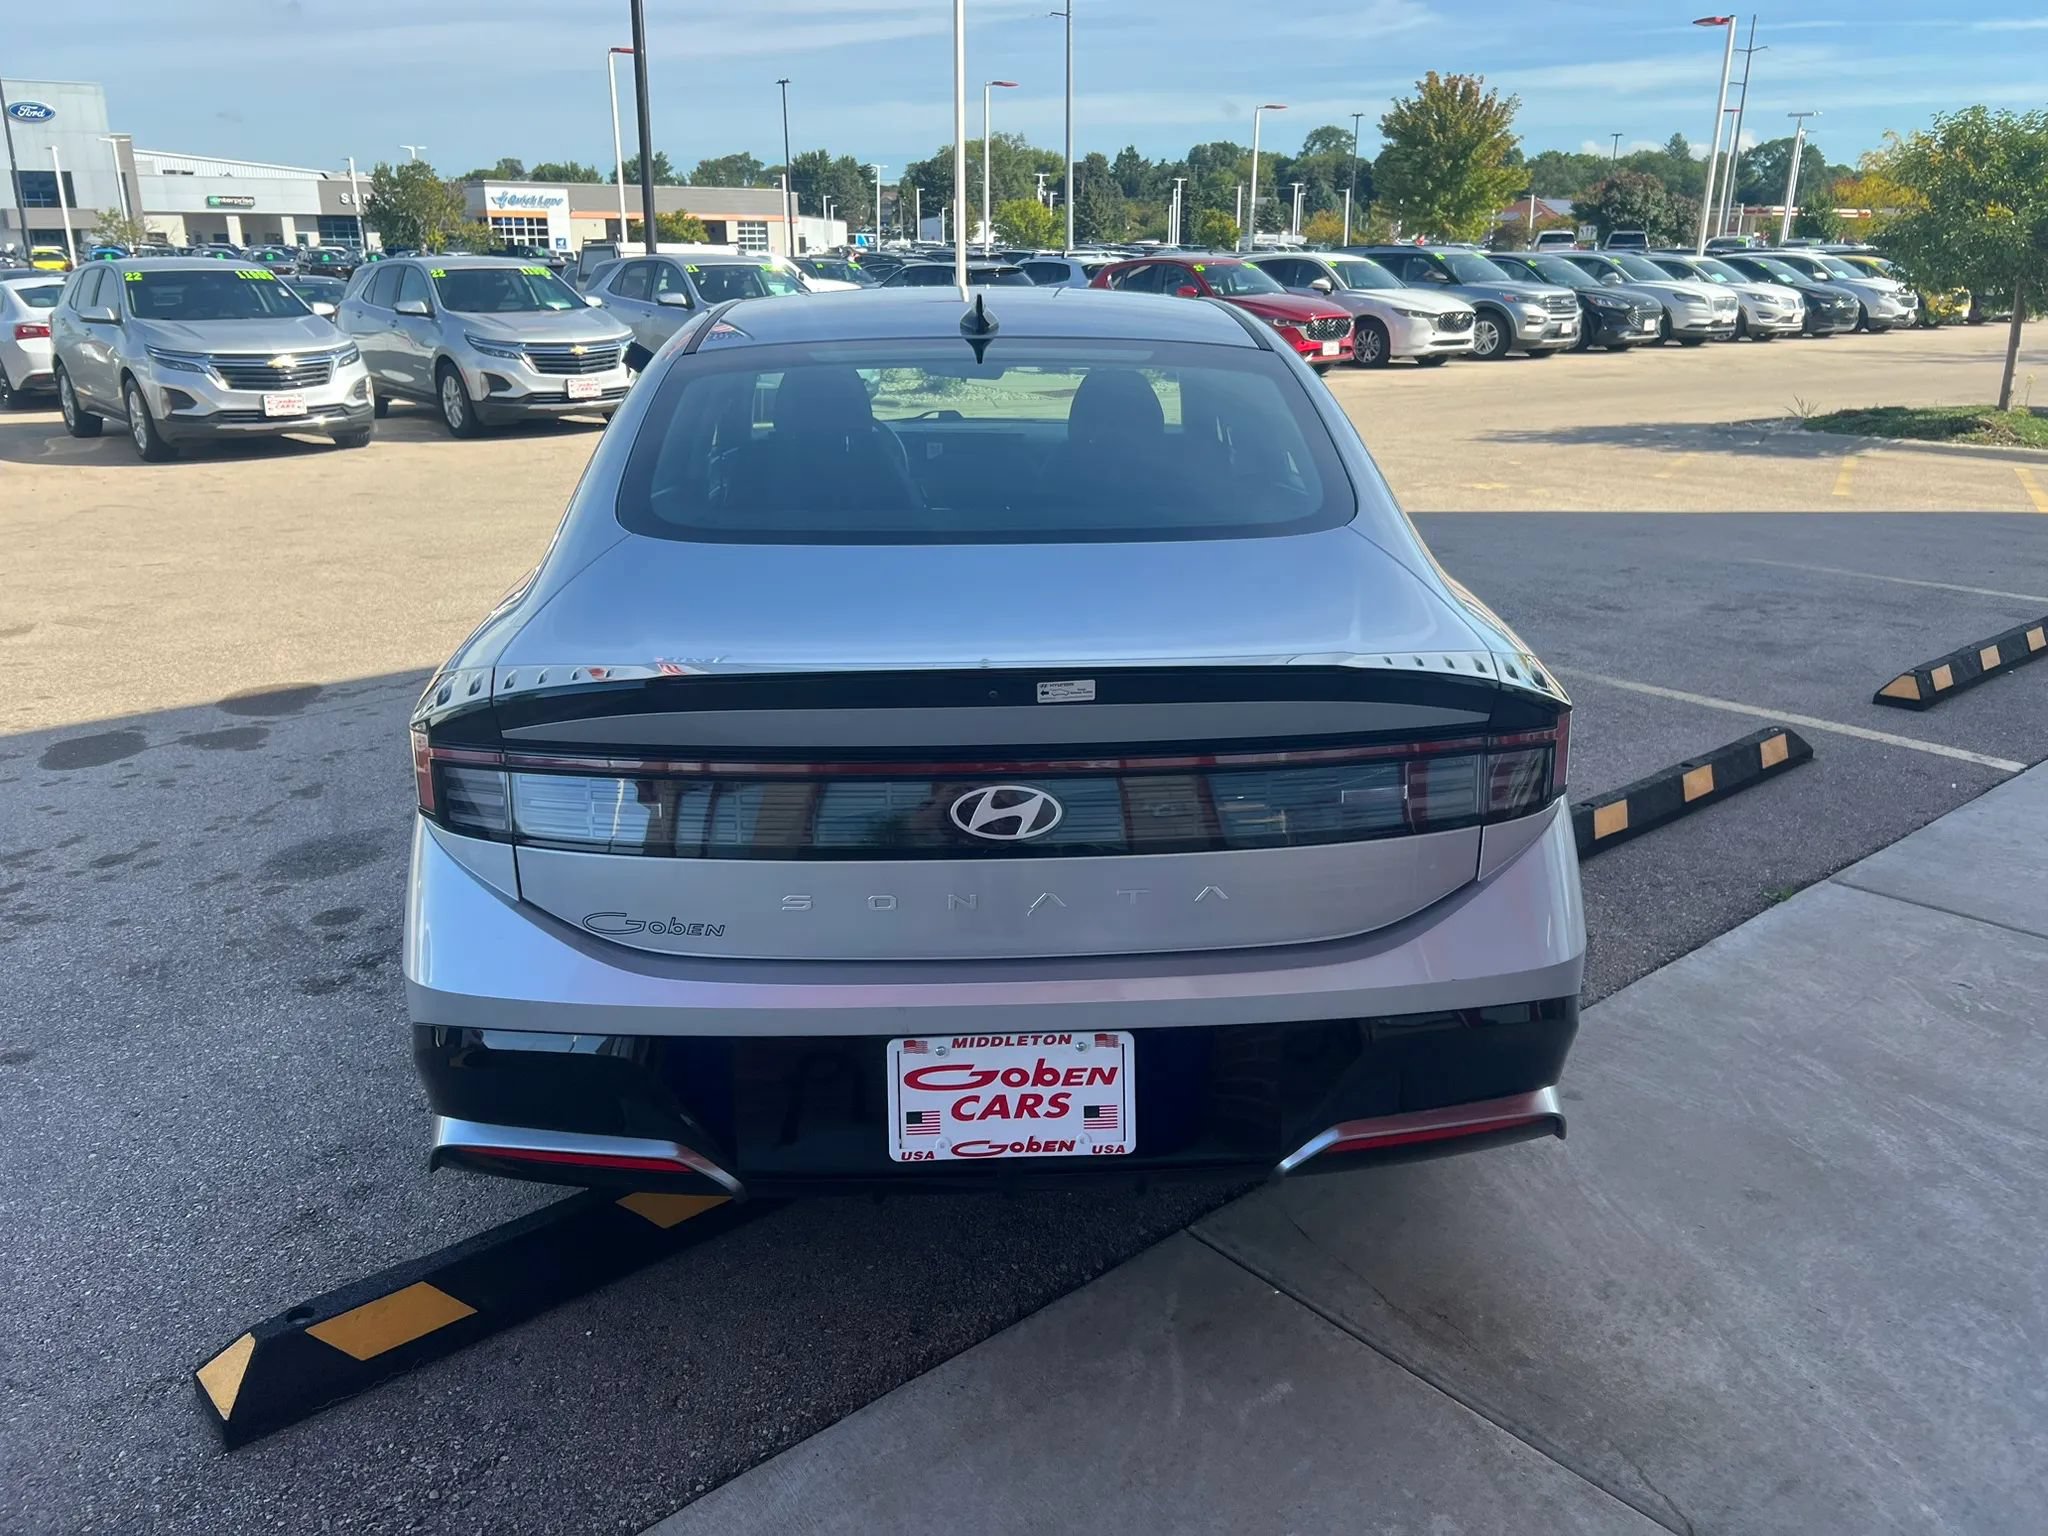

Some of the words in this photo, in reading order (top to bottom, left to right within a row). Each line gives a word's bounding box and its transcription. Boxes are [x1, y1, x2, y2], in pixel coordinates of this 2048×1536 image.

[17, 105, 46, 117] Ford
[125, 272, 142, 281] 22
[782, 886, 1229, 917] SONATA
[951, 1034, 1072, 1049] MIDDLETON
[951, 1092, 1072, 1122] CARS
[1091, 1144, 1126, 1155] USA
[901, 1151, 935, 1161] USA
